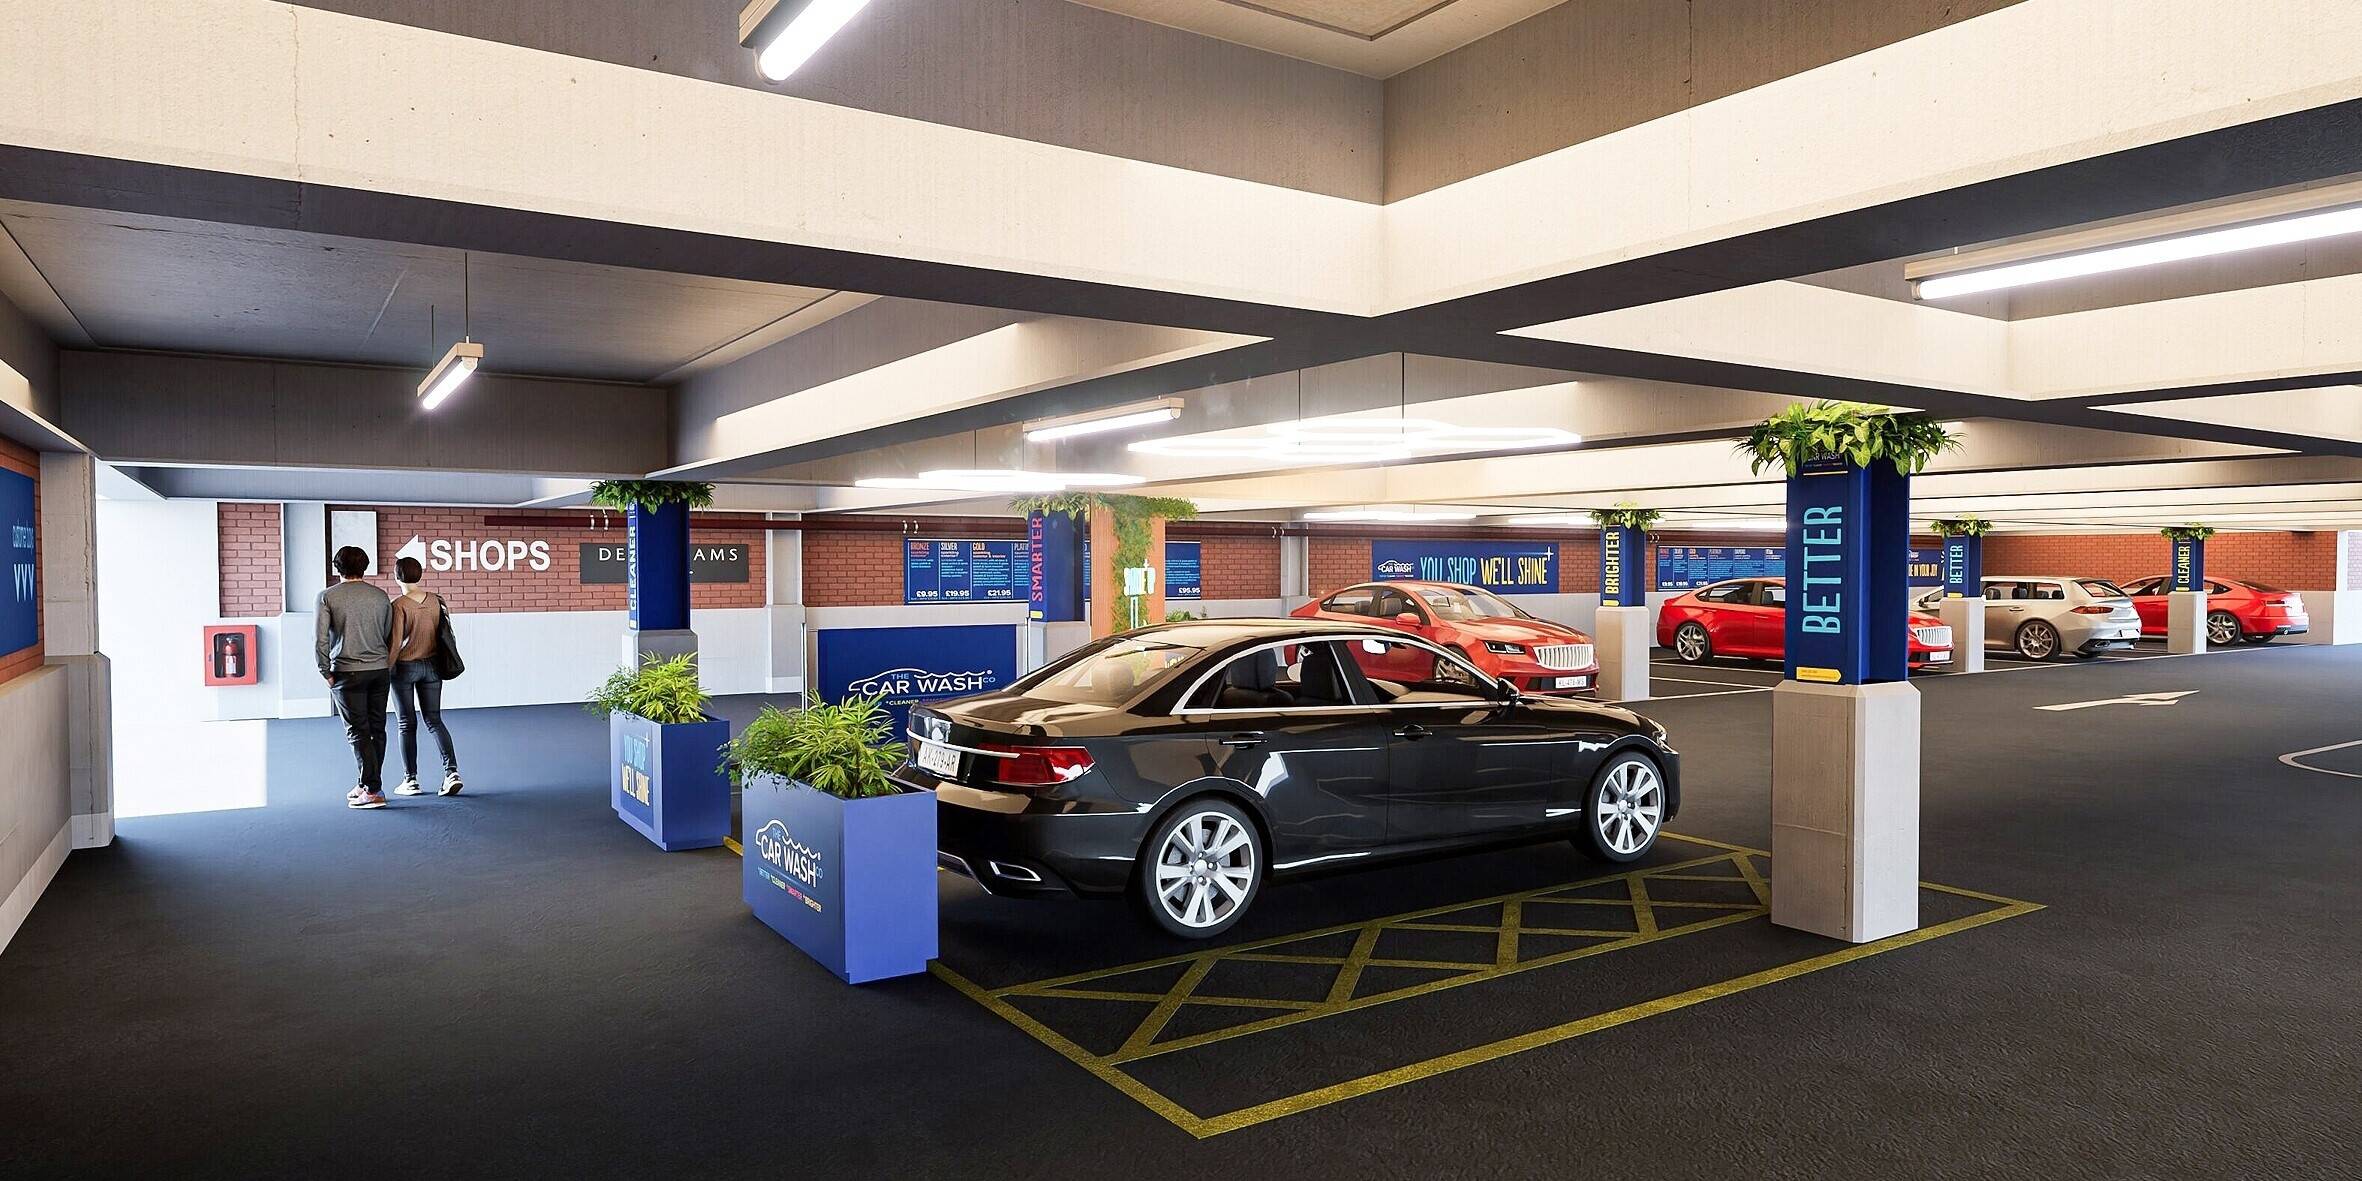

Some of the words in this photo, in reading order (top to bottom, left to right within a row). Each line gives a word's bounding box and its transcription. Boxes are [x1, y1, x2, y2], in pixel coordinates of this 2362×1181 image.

[430, 540, 551, 572] SHOPS
[940, 542, 958, 551] SILVER
[972, 542, 986, 551] GOLD
[1031, 517, 1043, 602] SMARTER
[1605, 531, 1620, 594] BRIGHTER
[629, 526, 637, 611] CLEANER
[1381, 565, 1394, 573] CAR
[1394, 564, 1412, 573] WASH
[1420, 557, 1443, 581] YOU
[1447, 557, 1477, 585] SHOP
[1480, 557, 1514, 585] WE'LL
[1518, 557, 1548, 585] SHINE
[1802, 506, 1843, 633] BETTER
[1950, 545, 1963, 584] BETTER
[2178, 546, 2190, 584] CLEANER
[916, 590, 938, 598] £9.95
[987, 589, 1012, 597] £21.95
[862, 681, 909, 696] CAR
[918, 676, 983, 693] WASH
[983, 676, 996, 684] CO
[761, 834, 781, 867] CAR
[783, 846, 817, 888] WASH
